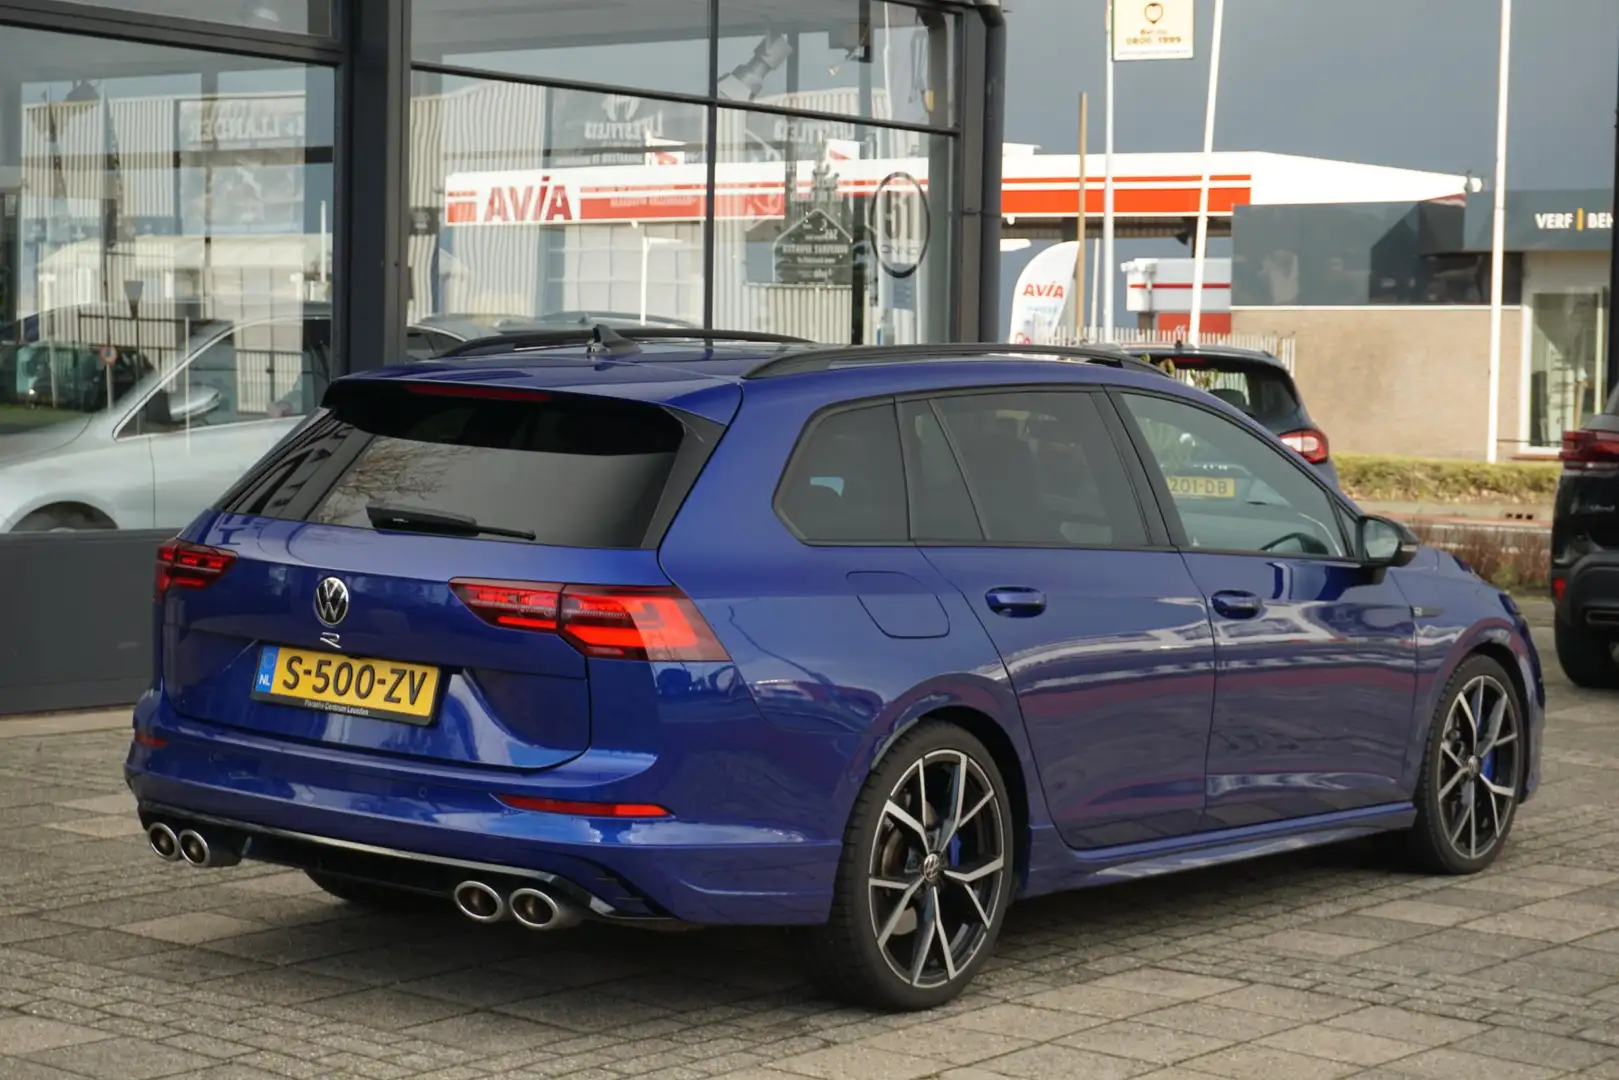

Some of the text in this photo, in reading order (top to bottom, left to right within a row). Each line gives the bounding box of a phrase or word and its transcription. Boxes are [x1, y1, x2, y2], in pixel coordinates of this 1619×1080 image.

[484, 175, 572, 222] AVIA
[1534, 212, 1574, 229] VERF
[1023, 281, 1064, 298] AVIA
[1168, 478, 1228, 495] 201-DB
[258, 674, 271, 686] NL
[282, 655, 428, 706] S-500-ZV
